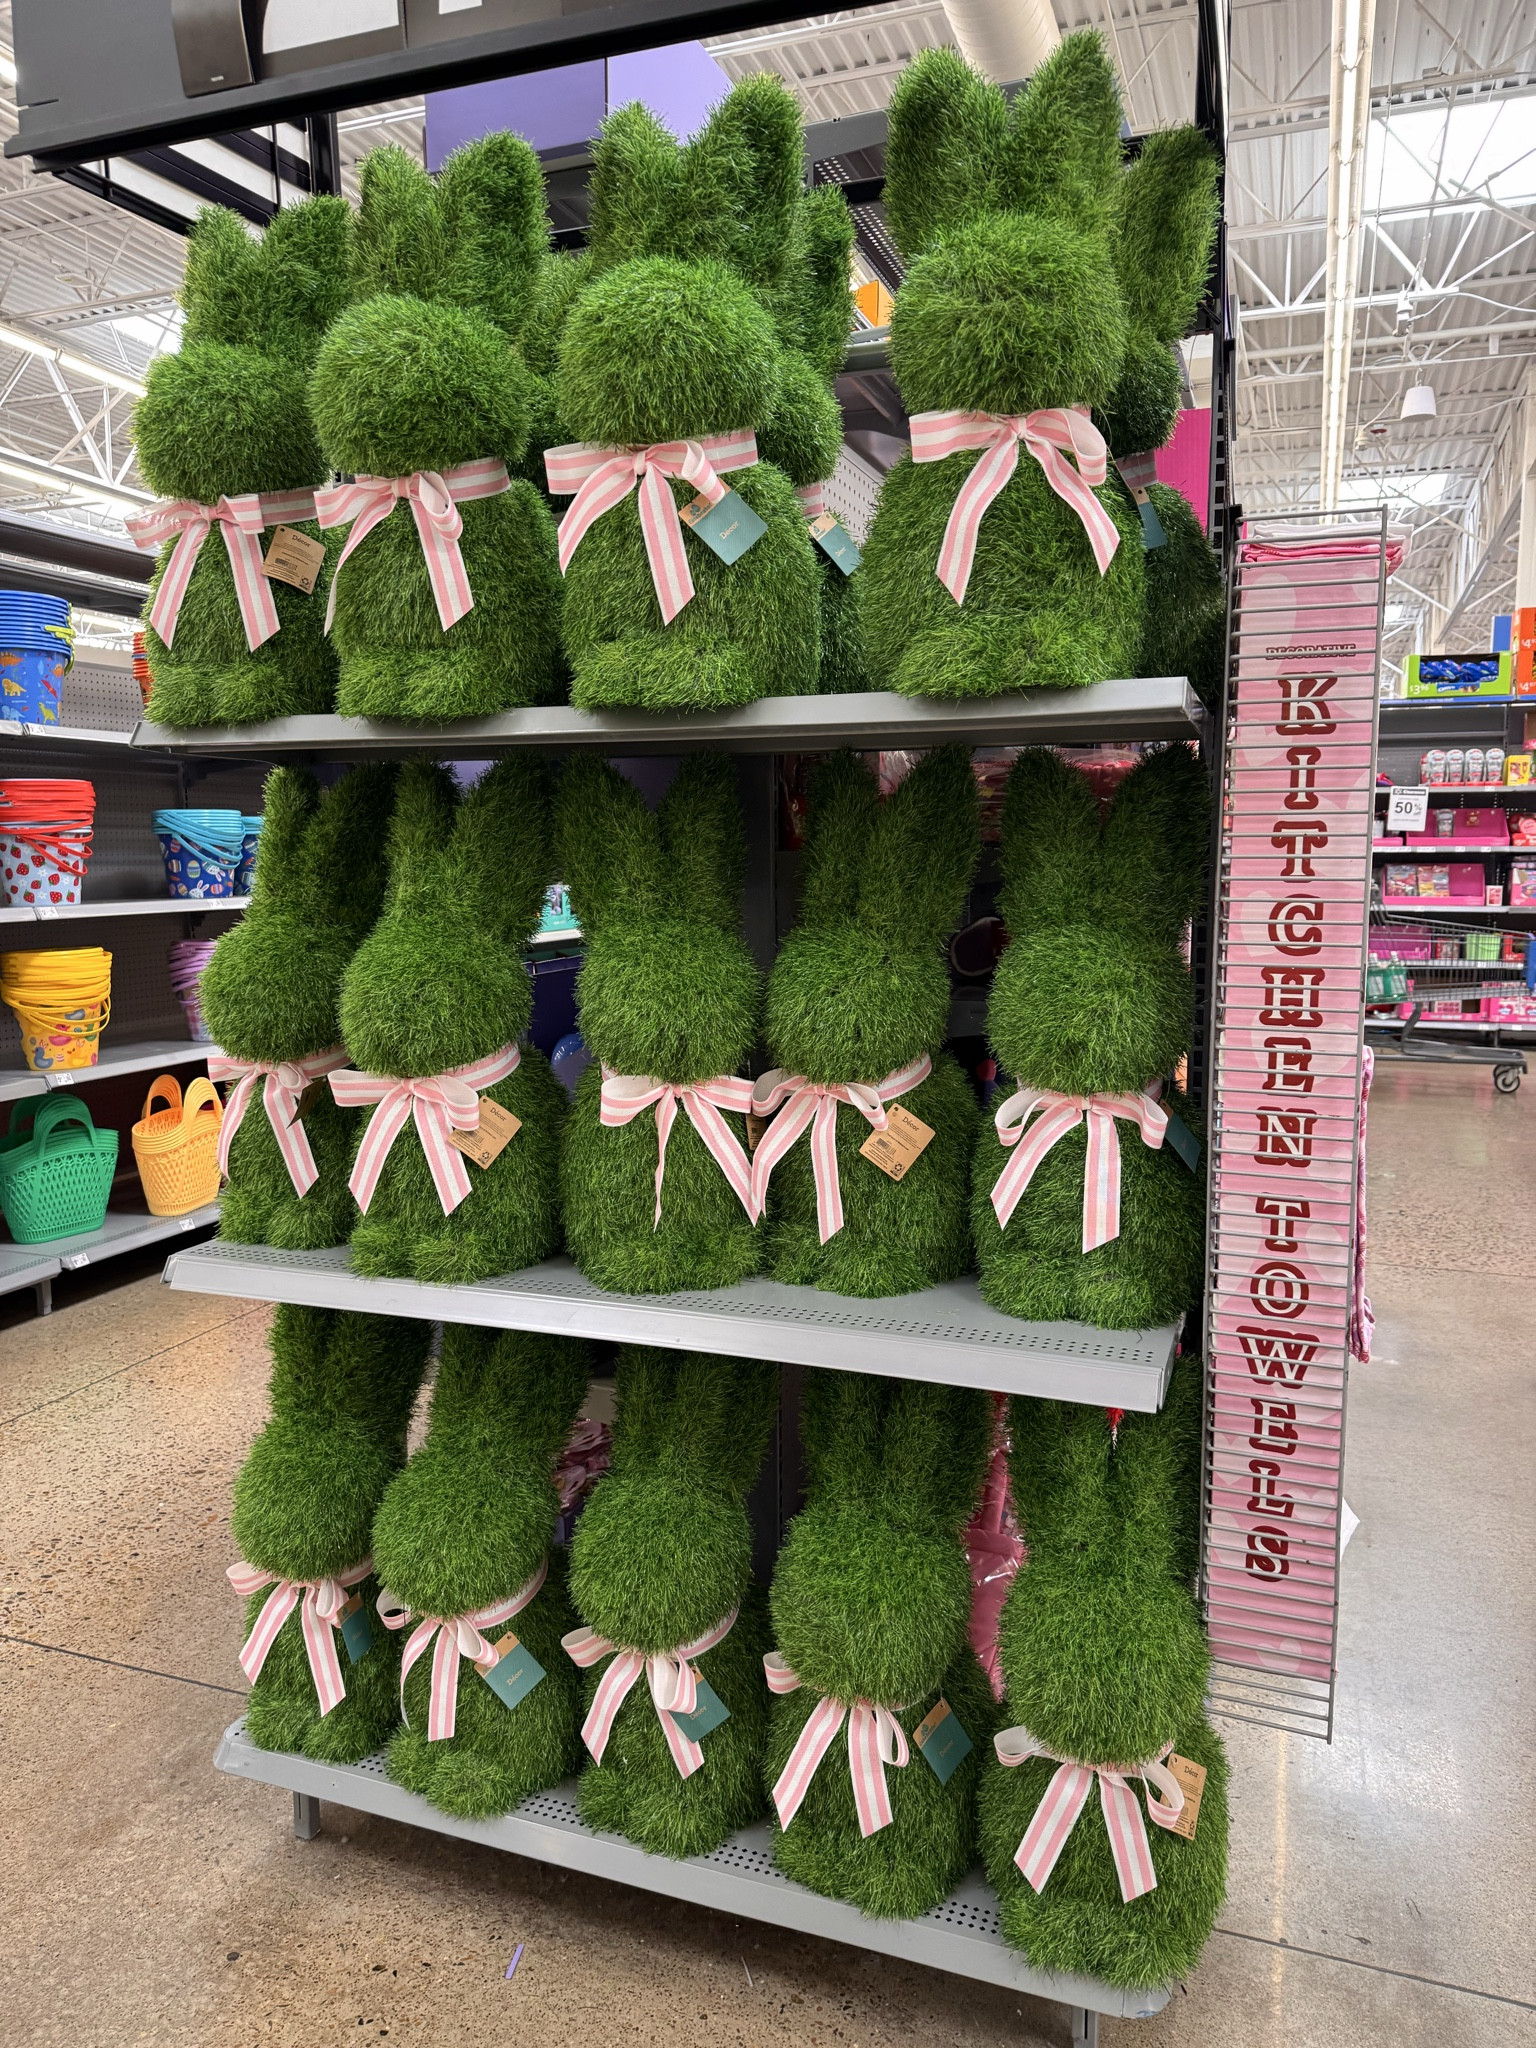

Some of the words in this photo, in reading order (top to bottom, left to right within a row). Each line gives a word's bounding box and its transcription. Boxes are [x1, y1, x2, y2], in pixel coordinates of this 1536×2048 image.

[291, 534, 311, 548] Décor
[1265, 644, 1356, 660] DECORATIVE
[1258, 671, 1339, 1167] KITCHEN
[489, 1107, 507, 1122] Décor
[902, 1116, 920, 1132] Décor
[1236, 1191, 1319, 1583] TOWELS
[1184, 1765, 1199, 1778] Décor
